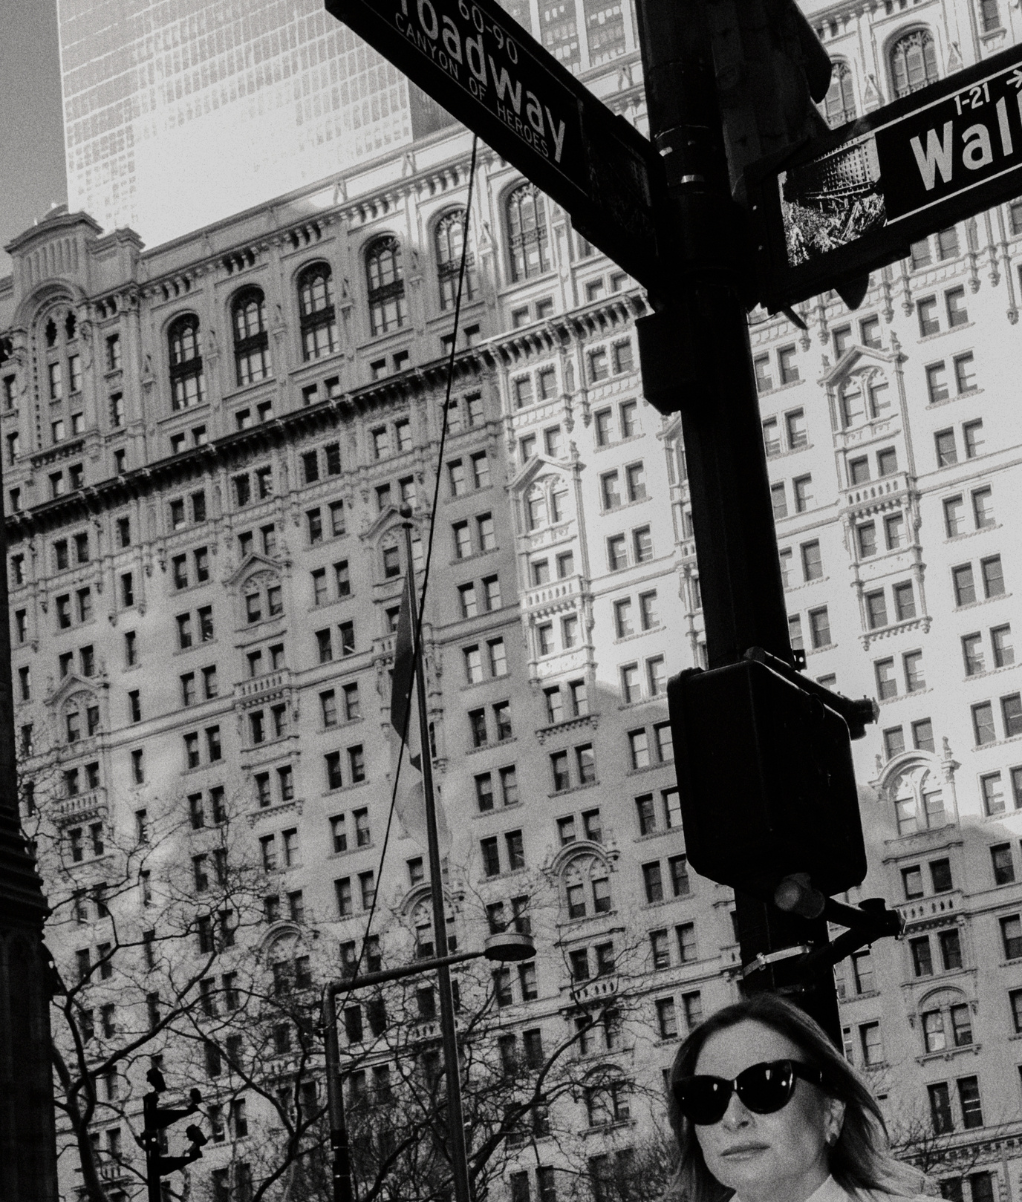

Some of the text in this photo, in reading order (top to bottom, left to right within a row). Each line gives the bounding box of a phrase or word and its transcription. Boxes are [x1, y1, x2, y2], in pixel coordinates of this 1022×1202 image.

[458, 0, 518, 65] 60-90
[395, 12, 550, 158] CANYON OF HEROES
[953, 82, 991, 116] 1-21
